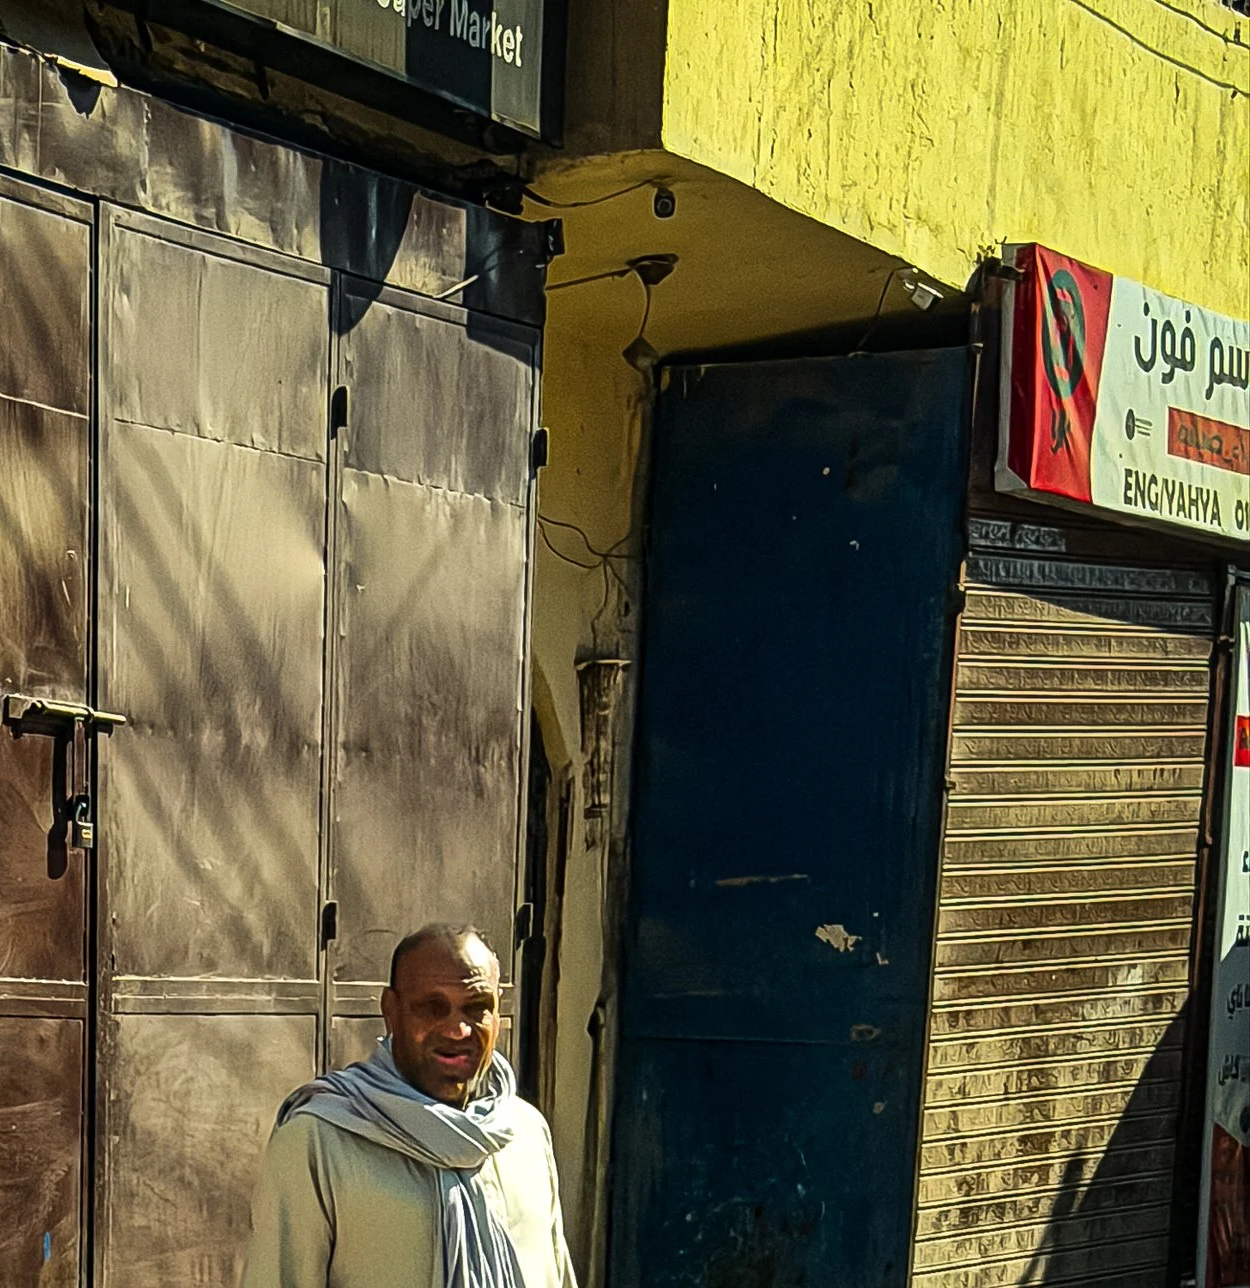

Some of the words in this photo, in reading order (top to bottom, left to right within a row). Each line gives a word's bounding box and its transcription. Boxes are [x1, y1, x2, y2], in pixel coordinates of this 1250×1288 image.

[376, 0, 444, 30] uper
[450, 0, 523, 67] Market
[1134, 301, 1196, 385] فون
[1123, 467, 1221, 527] ENG/YAHYA
